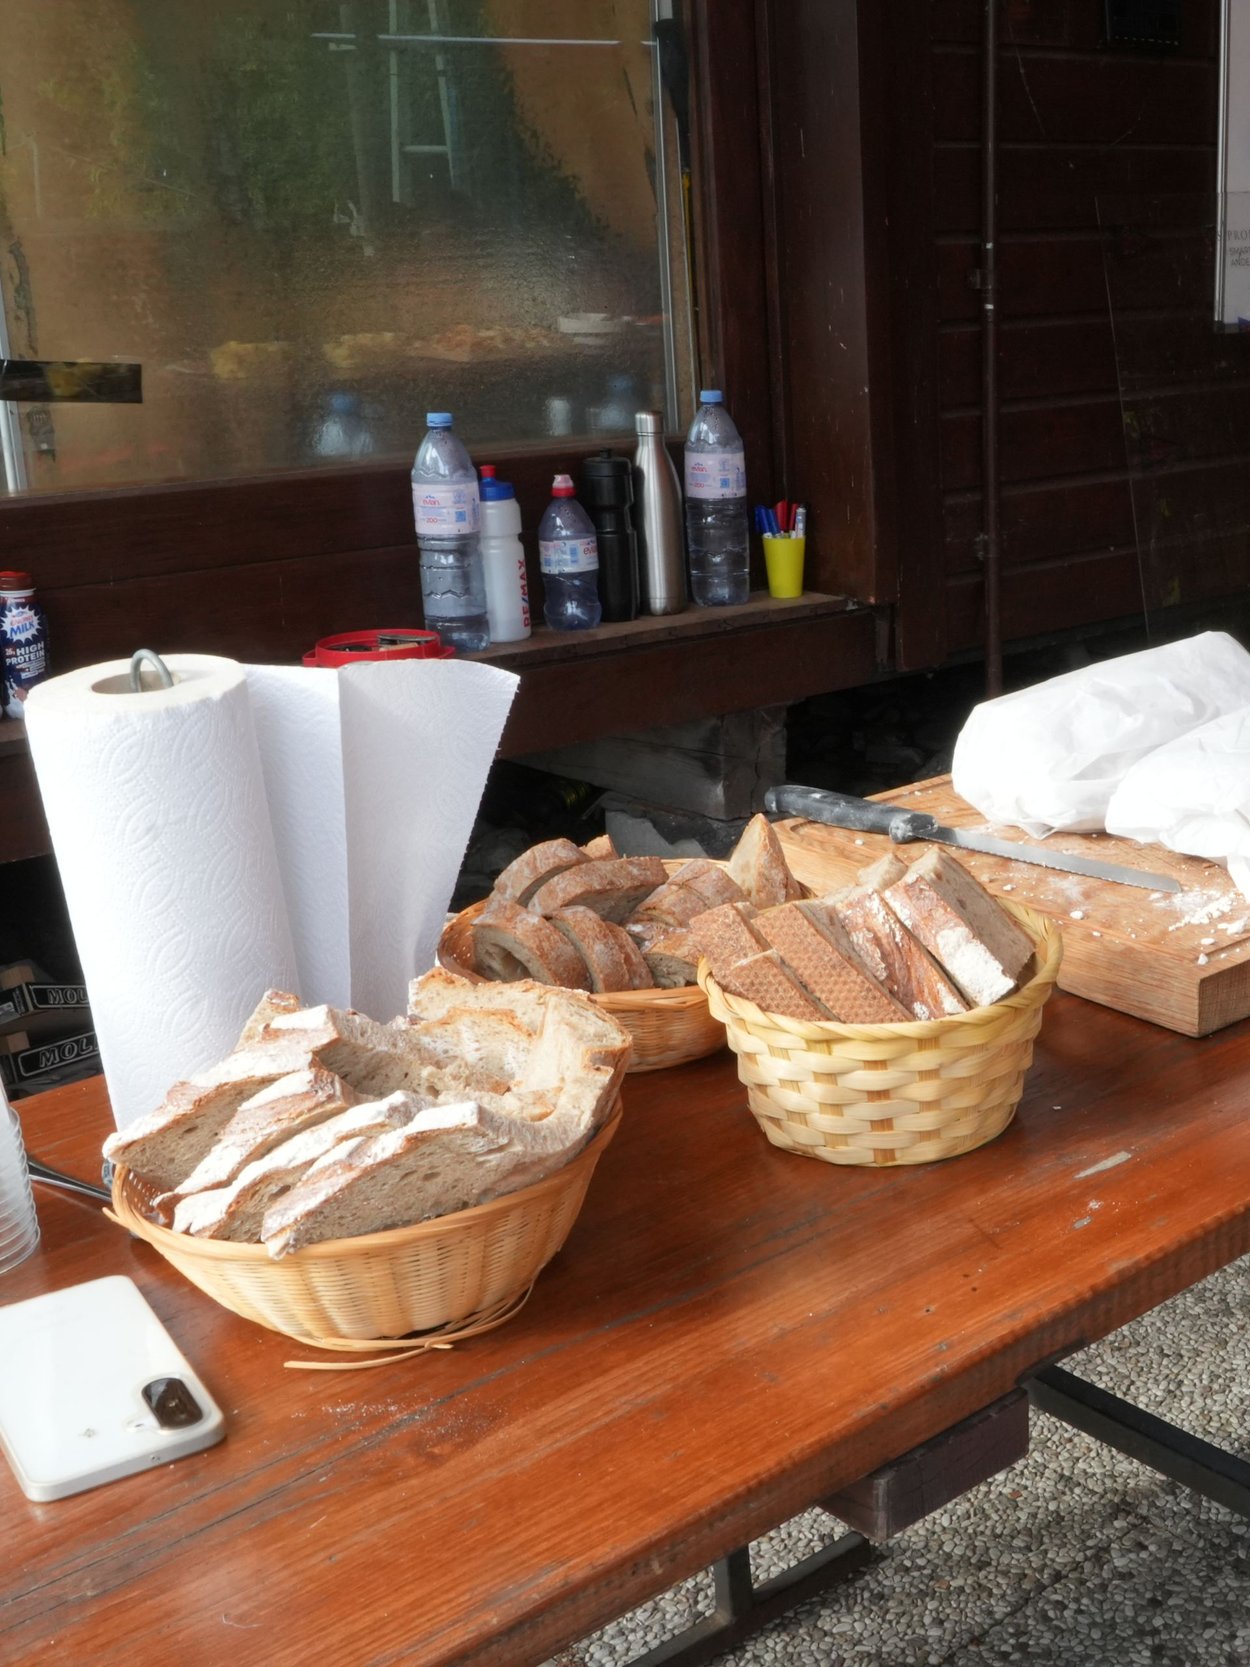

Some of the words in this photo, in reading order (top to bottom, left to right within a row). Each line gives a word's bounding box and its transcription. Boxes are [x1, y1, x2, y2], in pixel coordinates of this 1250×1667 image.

[518, 559, 530, 628] RE/MAX
[10, 622, 36, 638] MILK
[16, 641, 45, 657] HIGH
[5, 650, 46, 667] PROTEIN
[47, 988, 90, 1005] MOL
[39, 1037, 99, 1068] MOL
